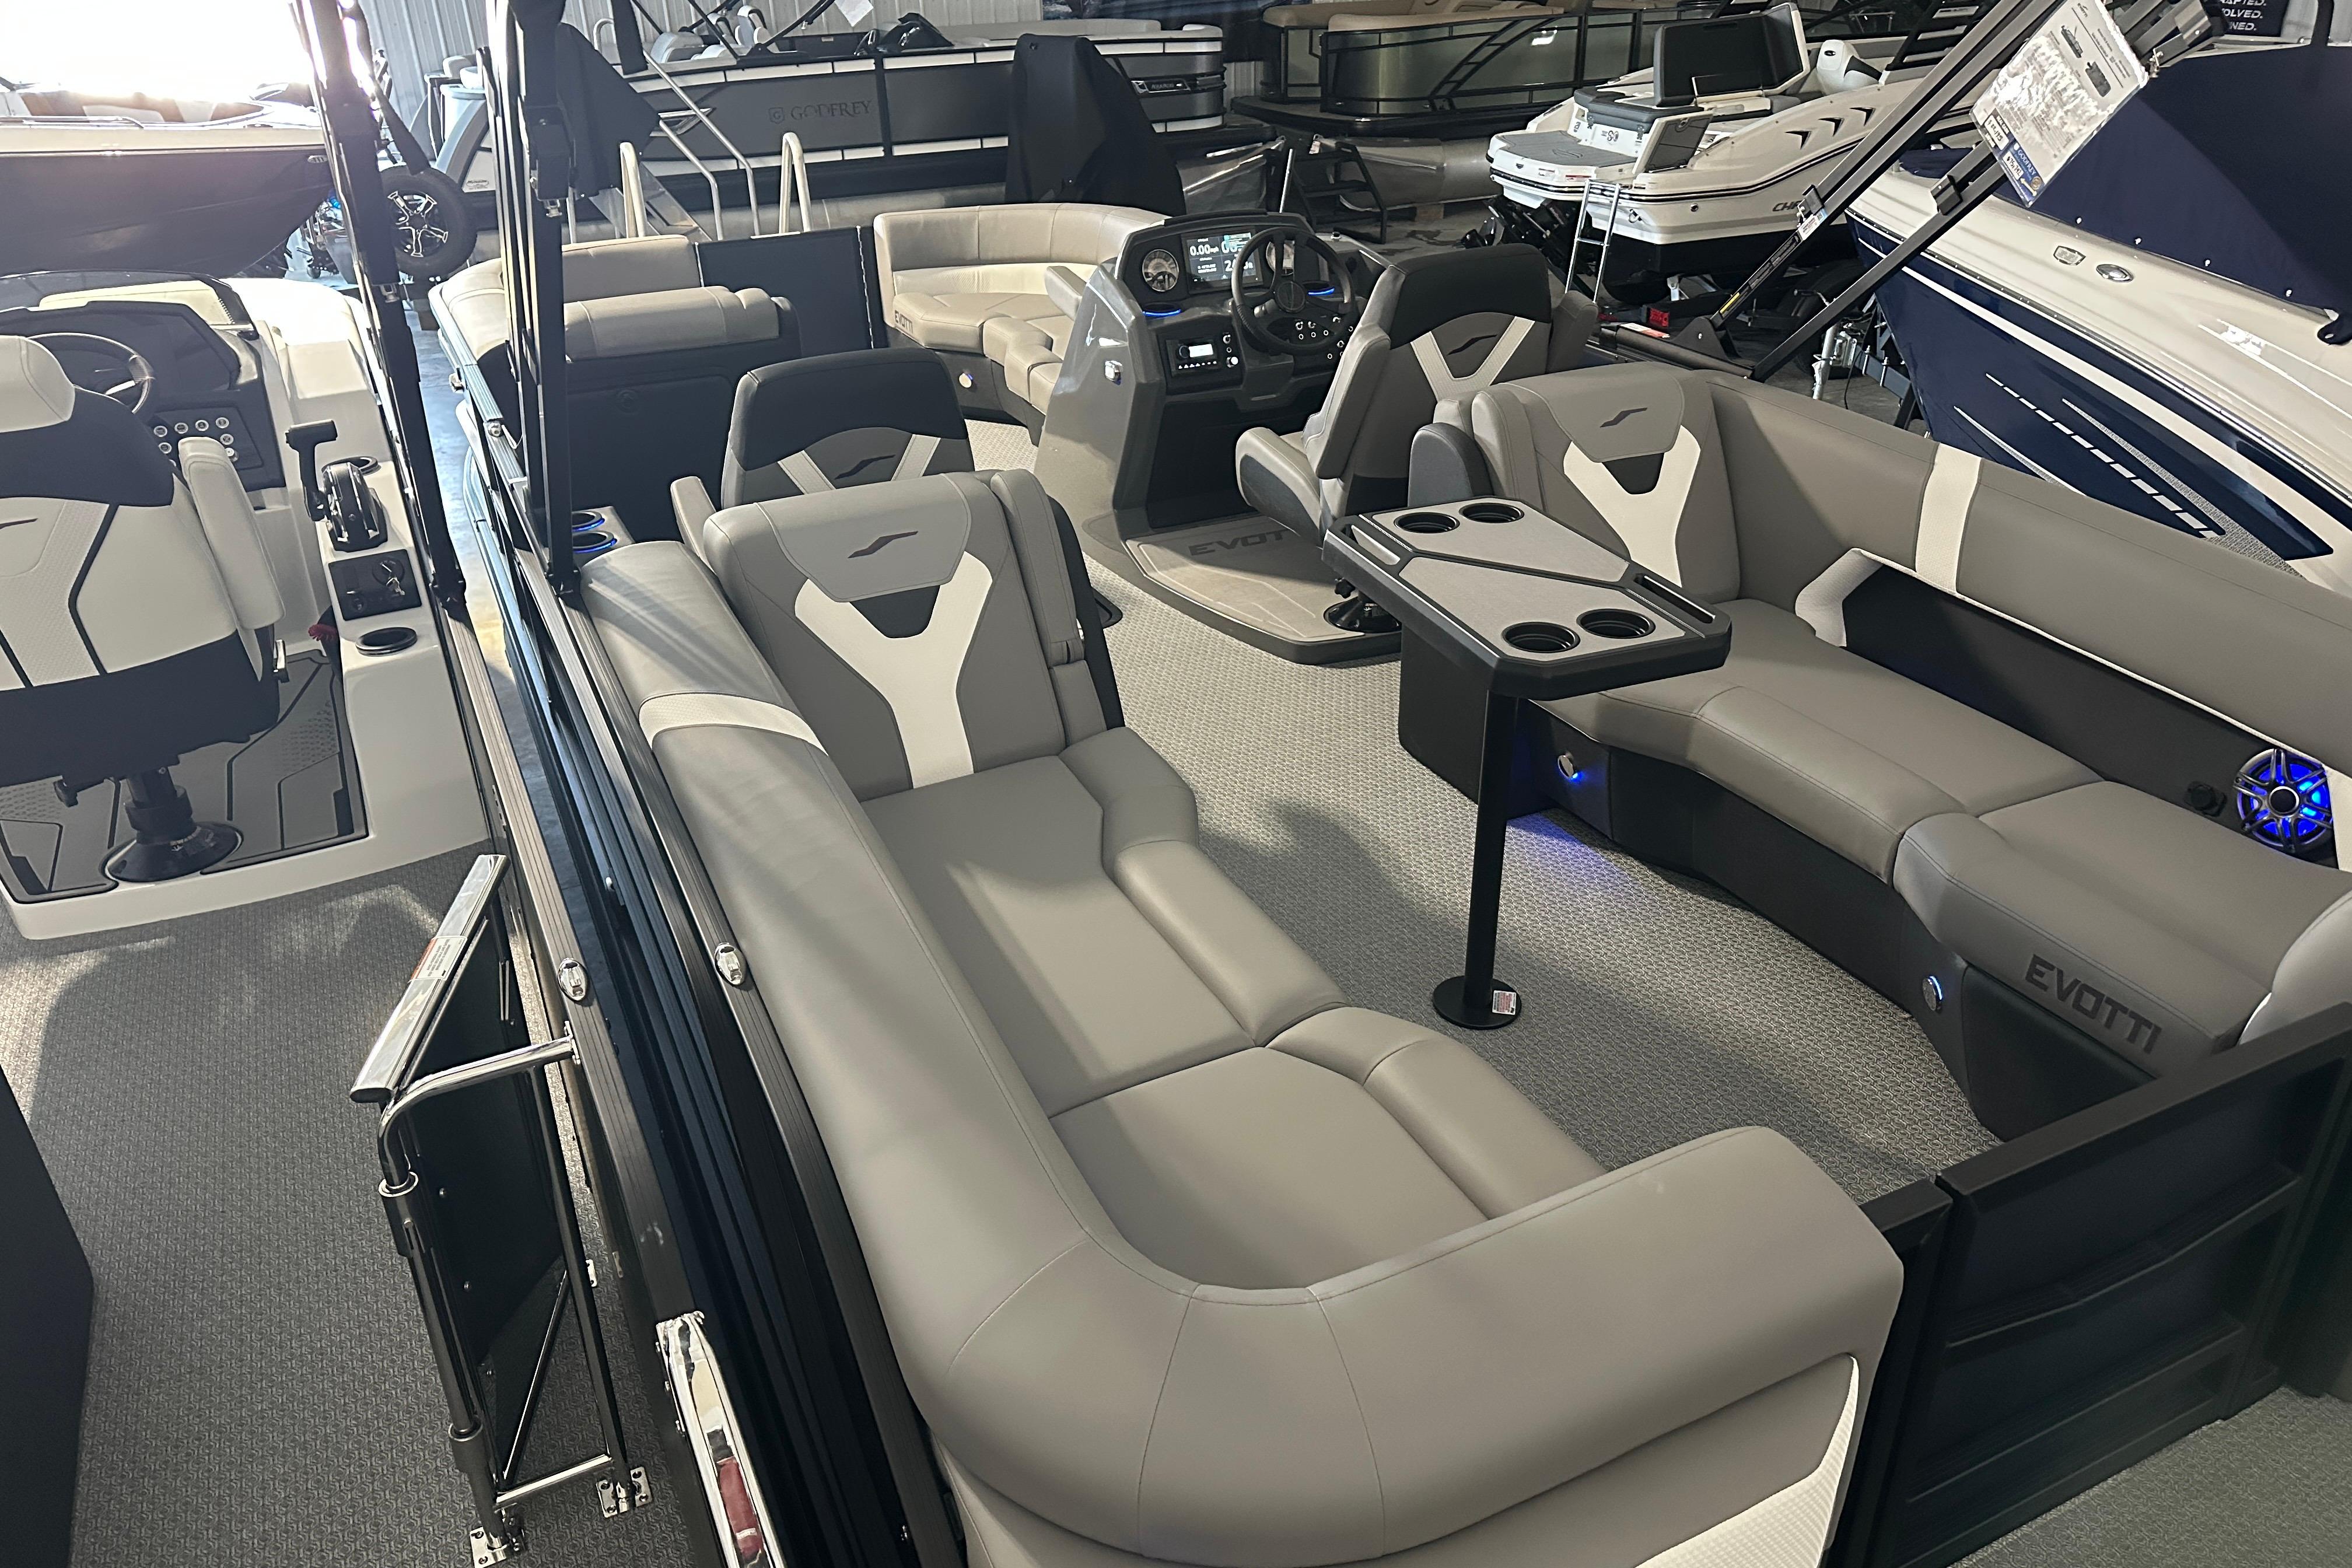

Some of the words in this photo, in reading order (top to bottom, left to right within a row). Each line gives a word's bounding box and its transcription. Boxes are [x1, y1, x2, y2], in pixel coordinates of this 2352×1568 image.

[2221, 8, 2263, 19] OLVED.
[2229, 22, 2257, 31] NED.
[791, 100, 872, 120] GODFREY
[894, 310, 914, 334] EVOTTI
[1188, 528, 1290, 556] EVOT
[2025, 953, 2162, 1055] EVOTTI
